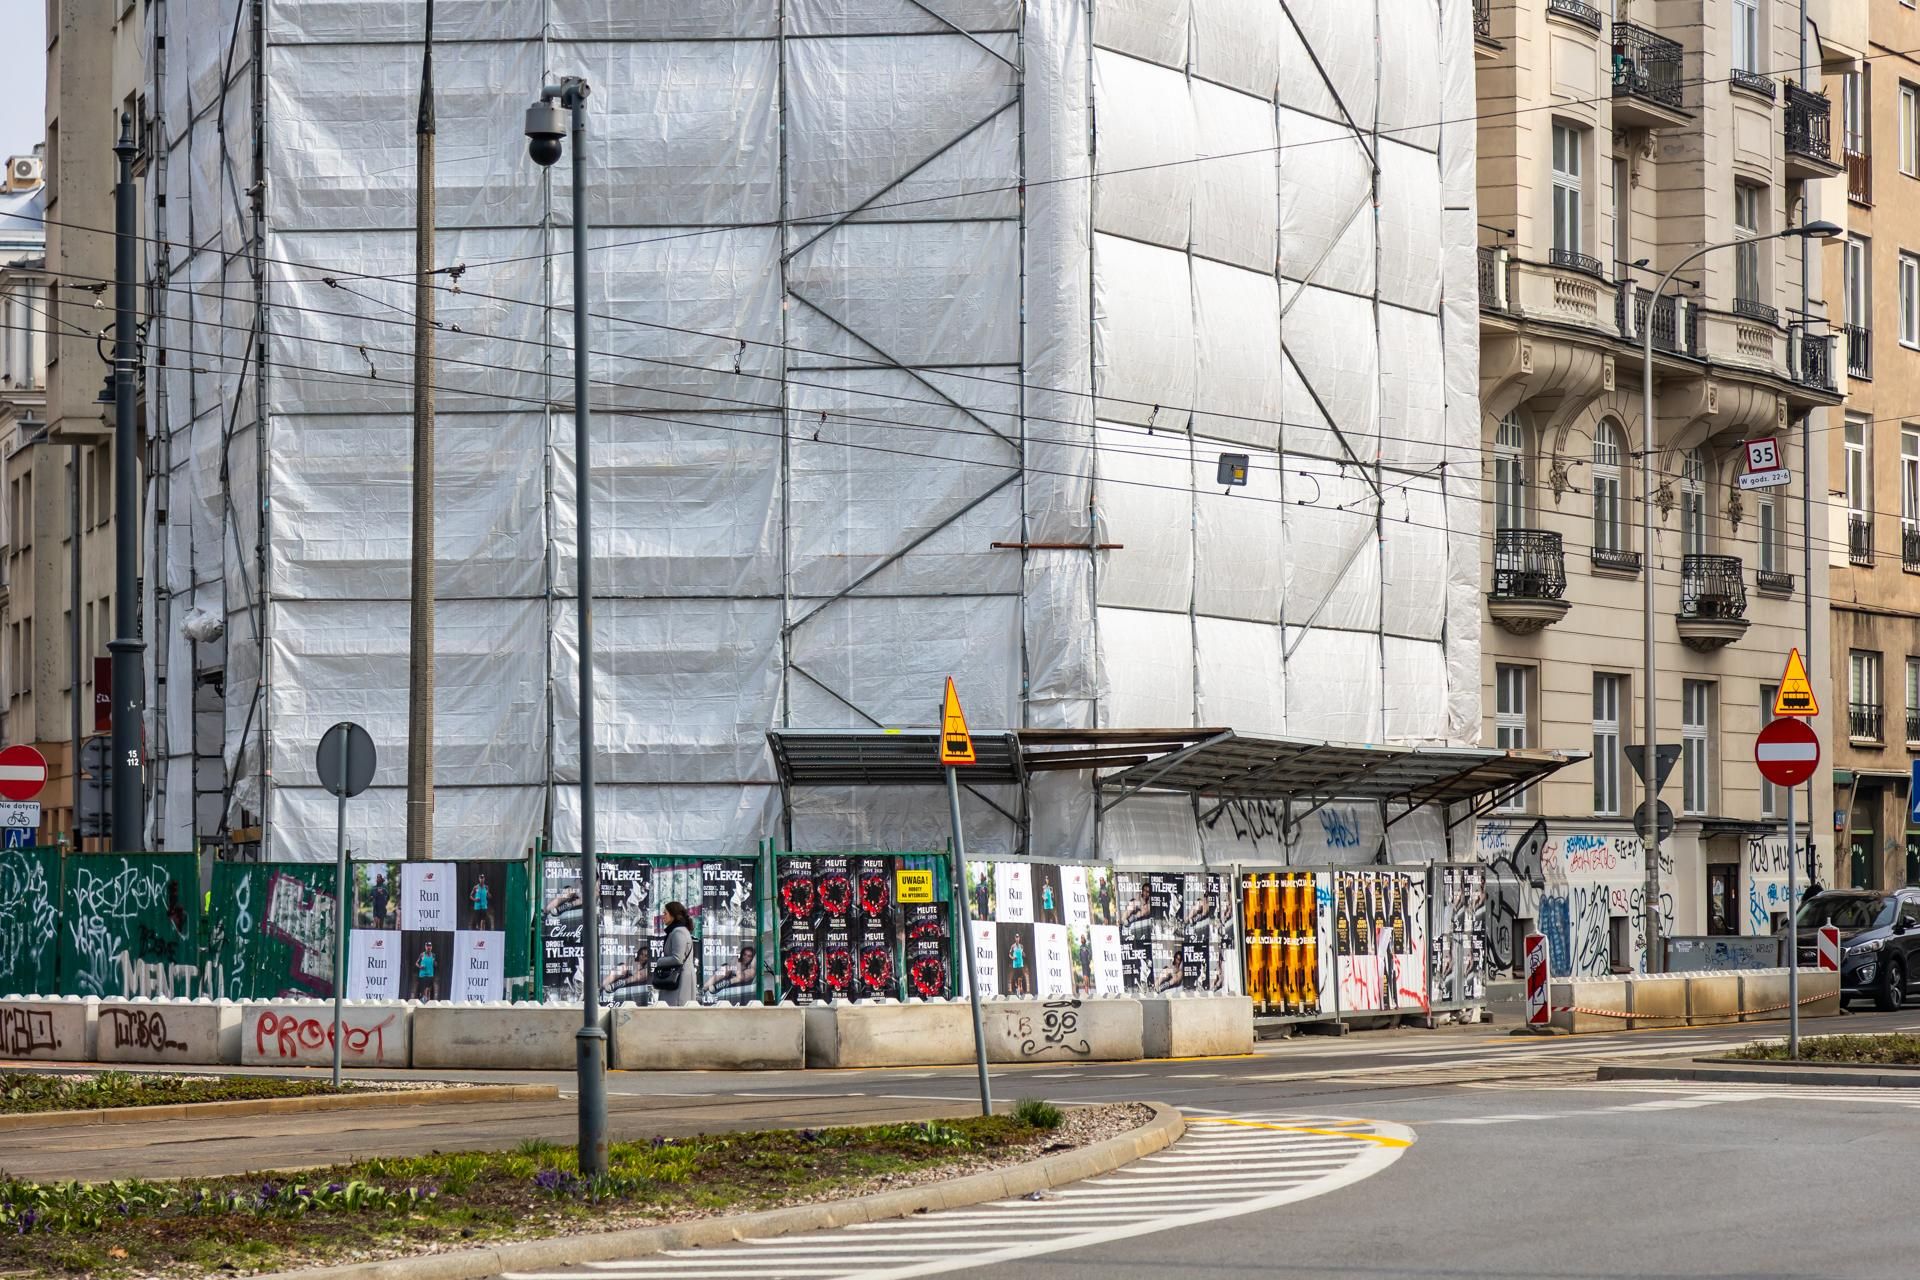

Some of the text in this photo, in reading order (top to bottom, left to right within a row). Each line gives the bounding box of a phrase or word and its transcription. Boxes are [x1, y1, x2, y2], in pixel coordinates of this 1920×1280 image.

[1752, 447, 1774, 463] 35
[1772, 472, 1788, 480] 22-6
[790, 861, 812, 870] MEUTE
[601, 870, 644, 882] TYLERZE,
[704, 870, 746, 882] TYLERZE,
[902, 876, 928, 884] UWAGA!
[419, 890, 439, 902] Run
[418, 909, 440, 922] your
[600, 945, 638, 958] CHARLI,
[704, 945, 740, 958] CHARLI,
[977, 947, 993, 959] Run
[367, 956, 387, 969] Run
[470, 957, 489, 970] Run
[366, 976, 388, 989] your
[467, 977, 488, 990] your
